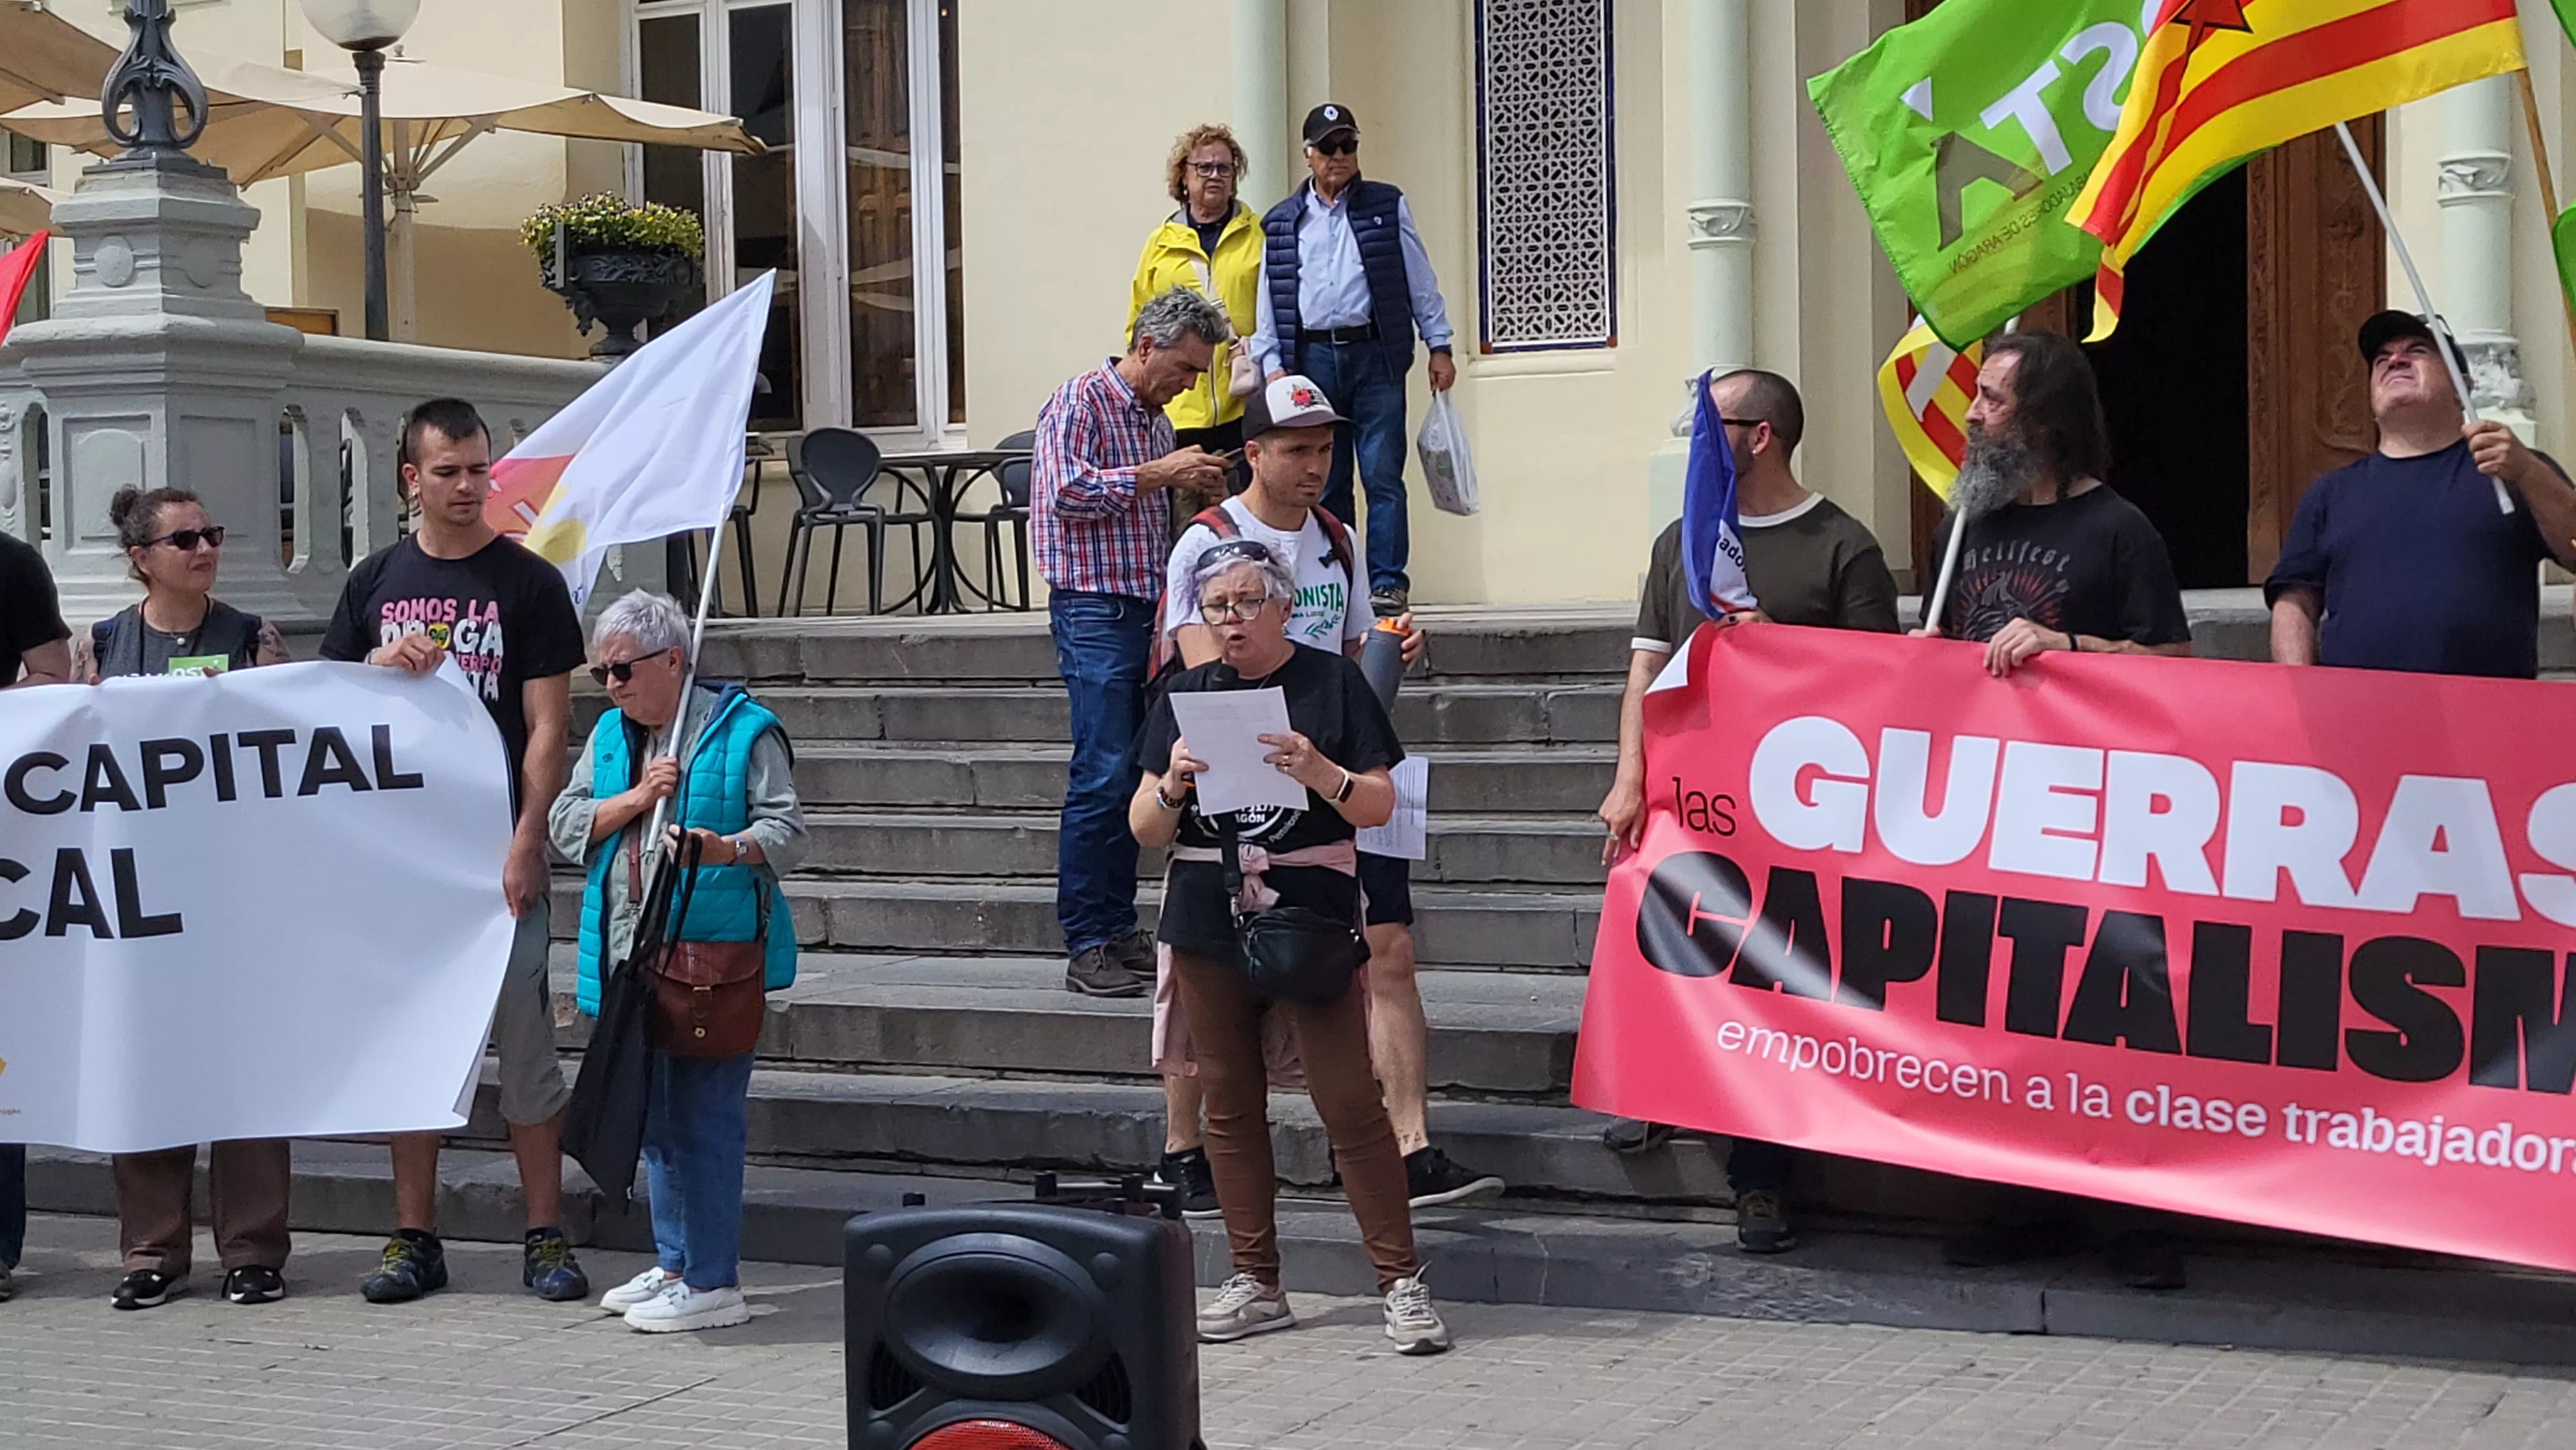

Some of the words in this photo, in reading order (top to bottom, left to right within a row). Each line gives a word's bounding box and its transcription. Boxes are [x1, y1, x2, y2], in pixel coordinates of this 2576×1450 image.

[381, 598, 457, 625] SOMOS
[468, 599, 499, 625] LA
[3, 724, 424, 816] CAPITAL
[1672, 777, 1737, 836] las
[1717, 1021, 2011, 1104] empobrecen
[2026, 1076, 2054, 1111] a
[2068, 1072, 2112, 1119] la
[2126, 1084, 2267, 1136] clase
[2283, 1102, 2576, 1174] trabajador
